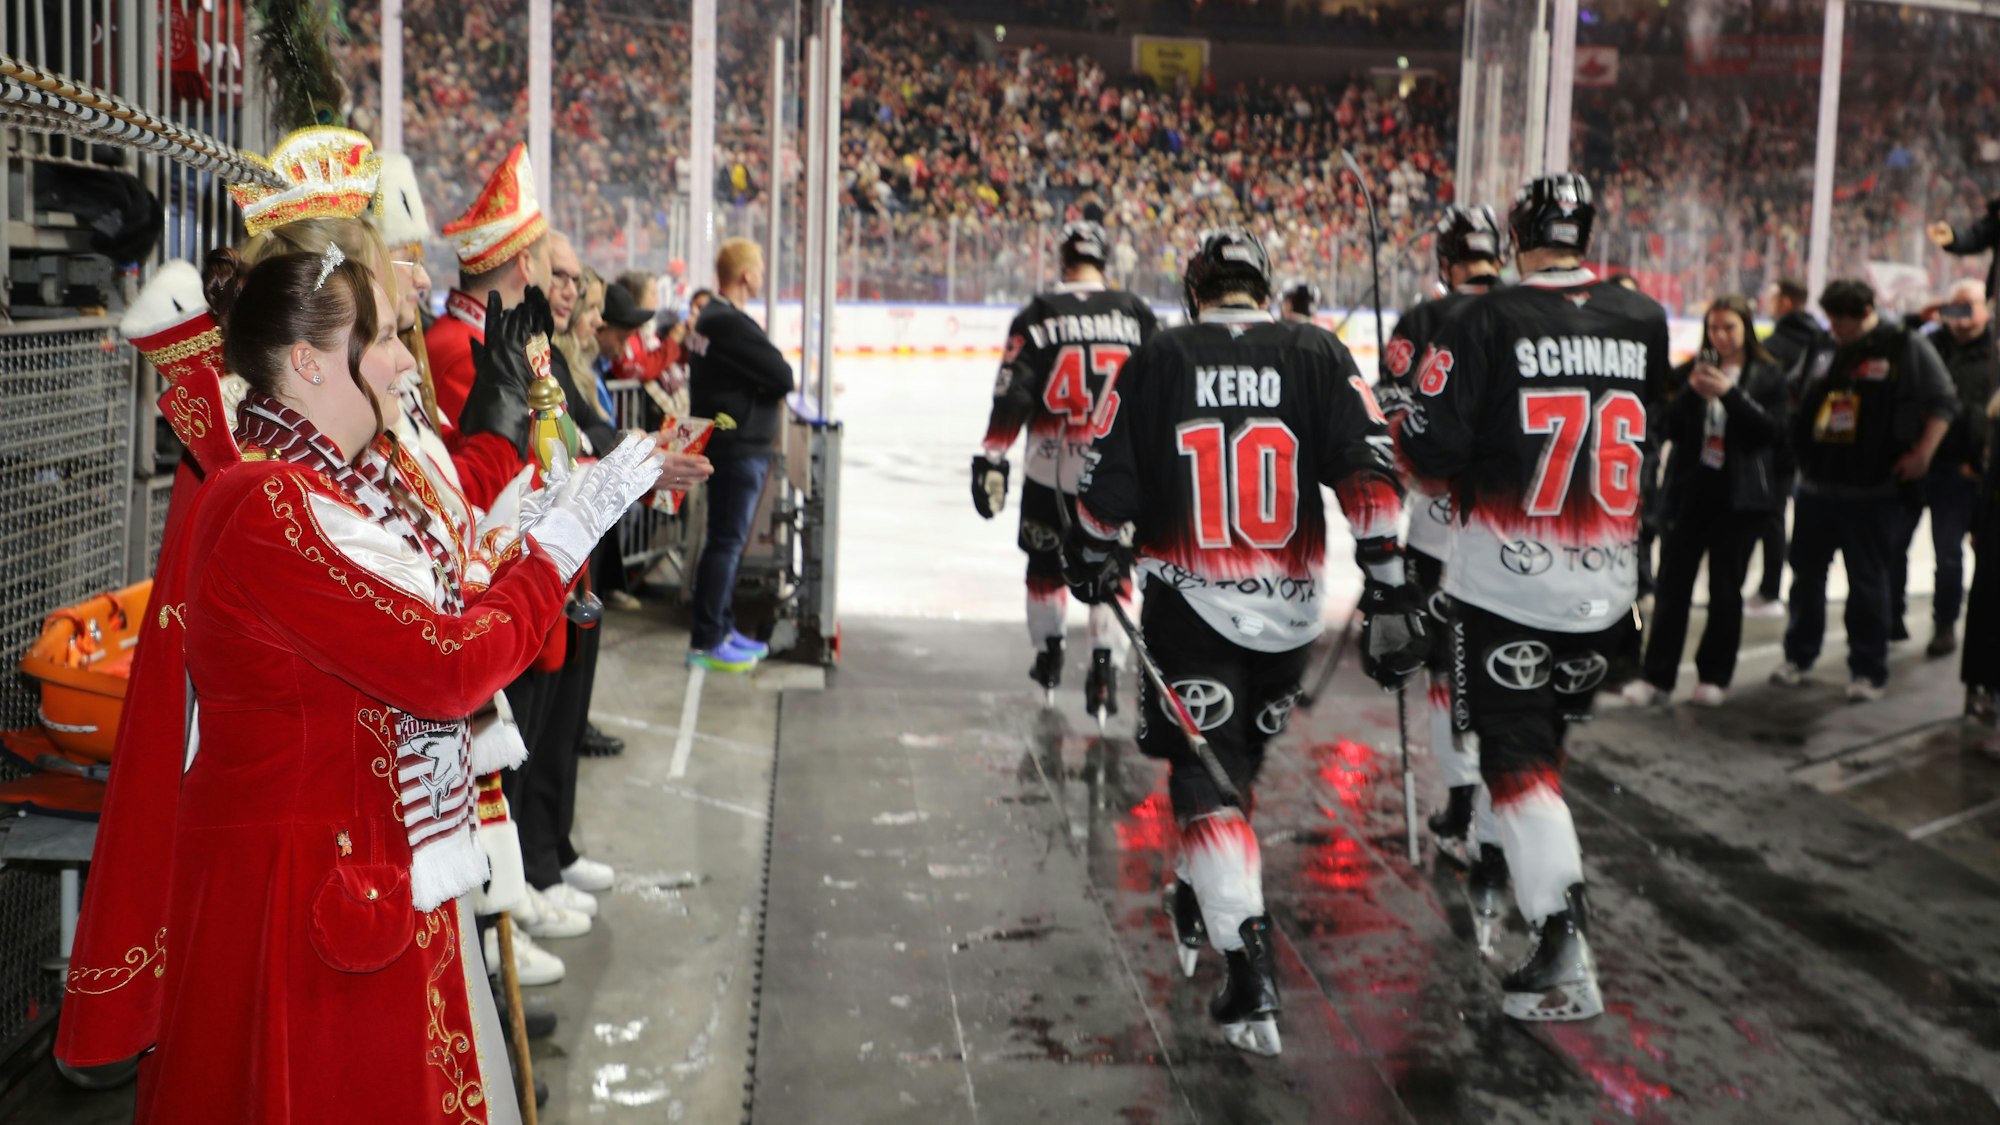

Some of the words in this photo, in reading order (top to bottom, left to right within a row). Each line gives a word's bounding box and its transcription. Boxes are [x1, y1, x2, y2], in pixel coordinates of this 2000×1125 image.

[1043, 343, 1131, 426] 47
[1195, 365, 1281, 408] KERO
[1176, 416, 1299, 549] 10
[1519, 387, 1647, 516] 76
